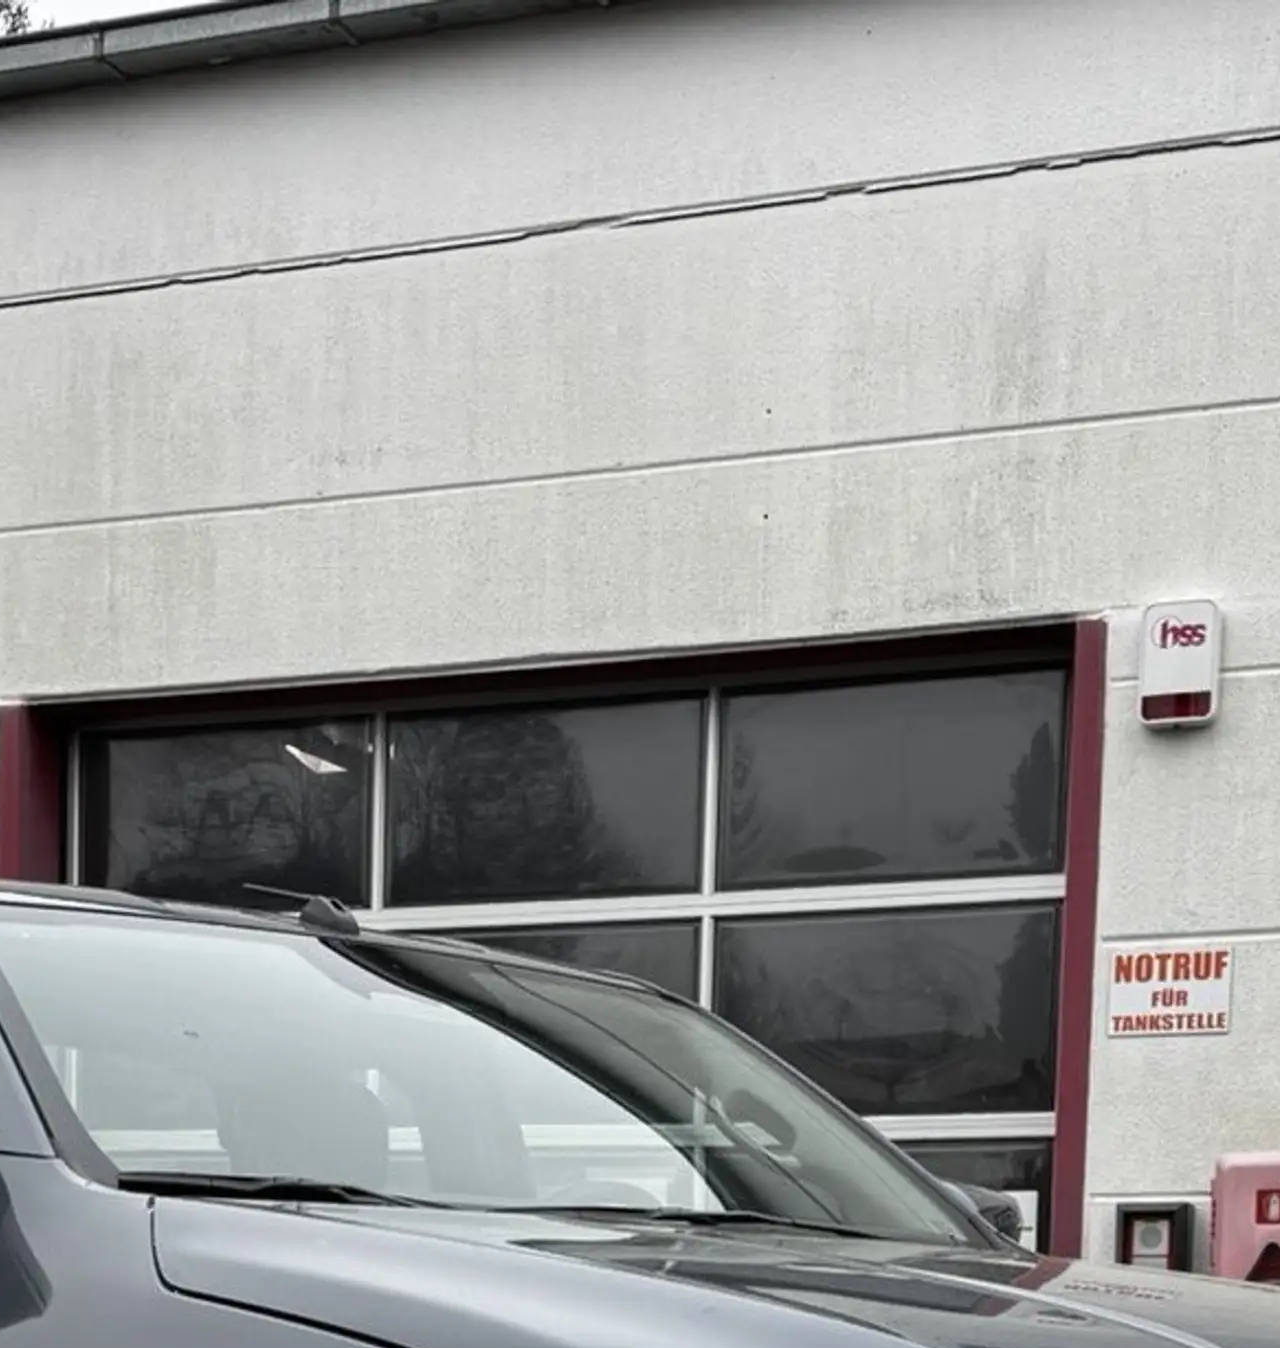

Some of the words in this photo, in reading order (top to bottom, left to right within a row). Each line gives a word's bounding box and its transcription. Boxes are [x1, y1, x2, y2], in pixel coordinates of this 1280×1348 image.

[1160, 619, 1207, 649] hss
[1114, 951, 1229, 983] NOTRUF
[1151, 988, 1188, 1007] FÜR
[1112, 1012, 1226, 1032] TANKSTELLE
